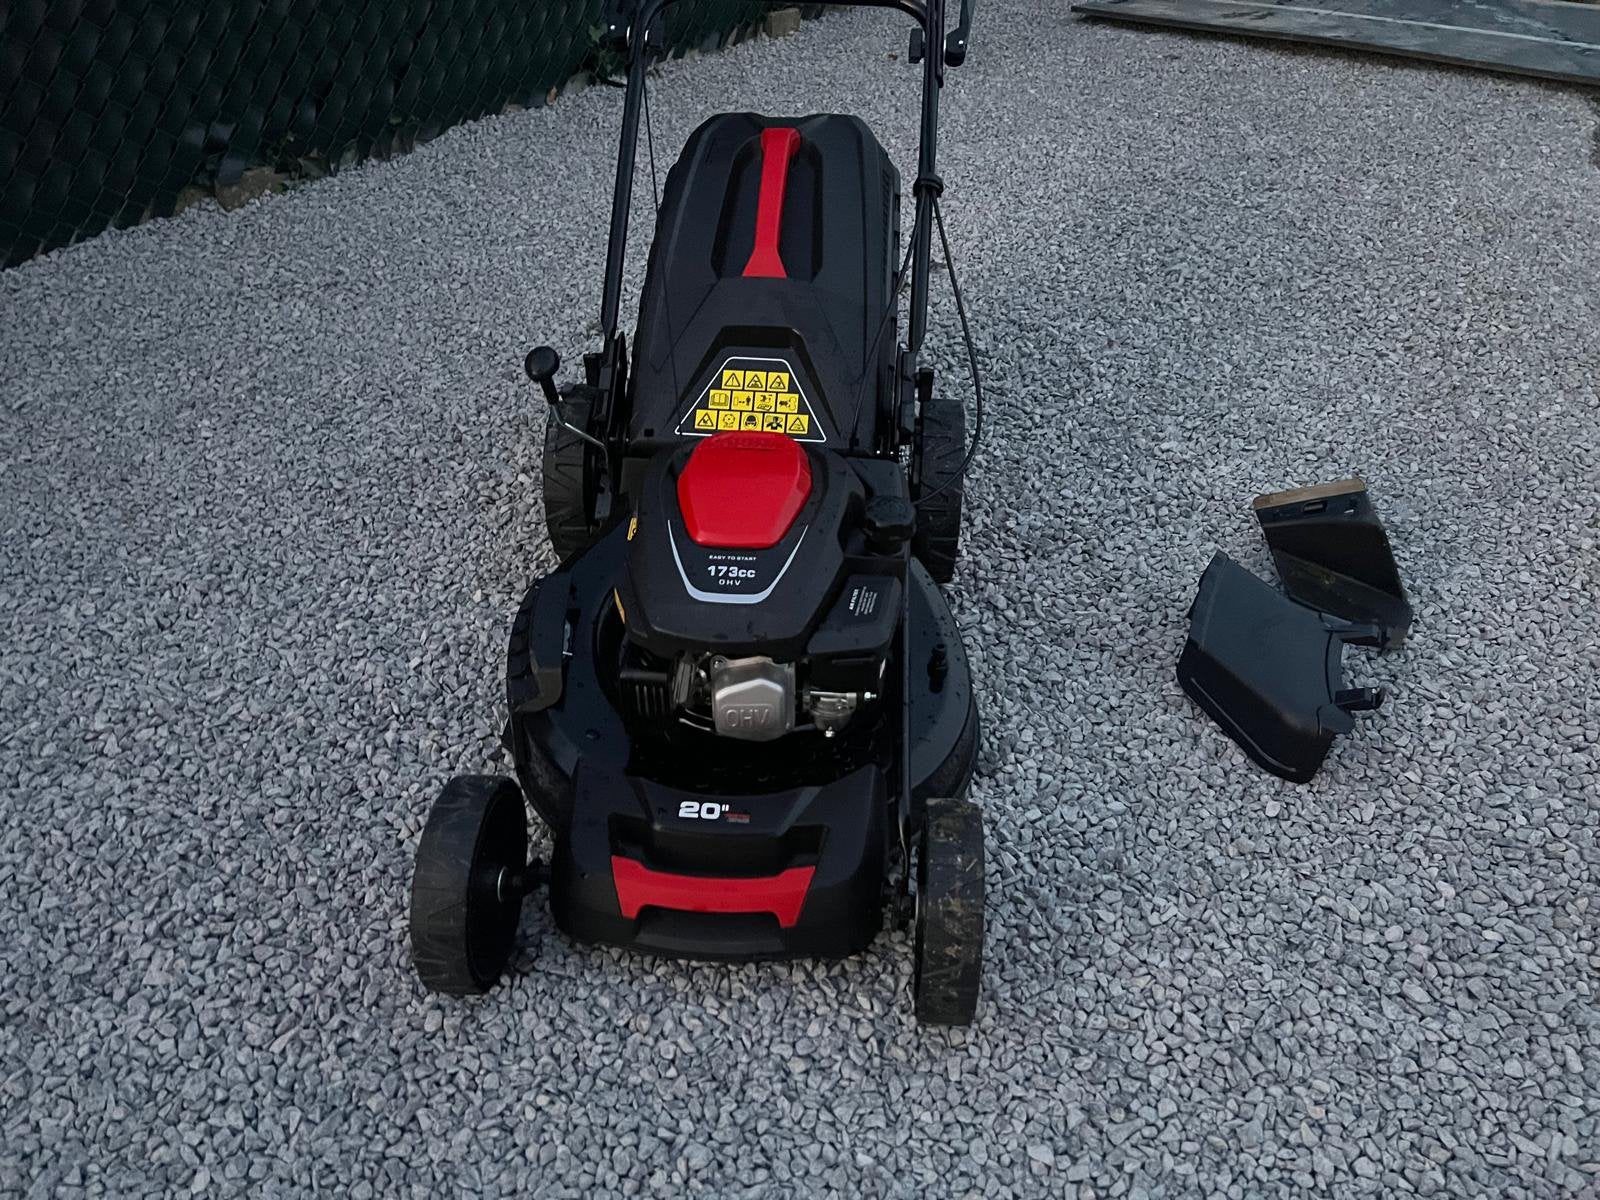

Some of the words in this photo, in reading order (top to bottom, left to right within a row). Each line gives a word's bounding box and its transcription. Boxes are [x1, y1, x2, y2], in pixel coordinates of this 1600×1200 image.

[707, 565, 756, 578] 173cc
[718, 578, 741, 586] OHV
[726, 709, 769, 728] OHV
[678, 801, 730, 820] 20"
